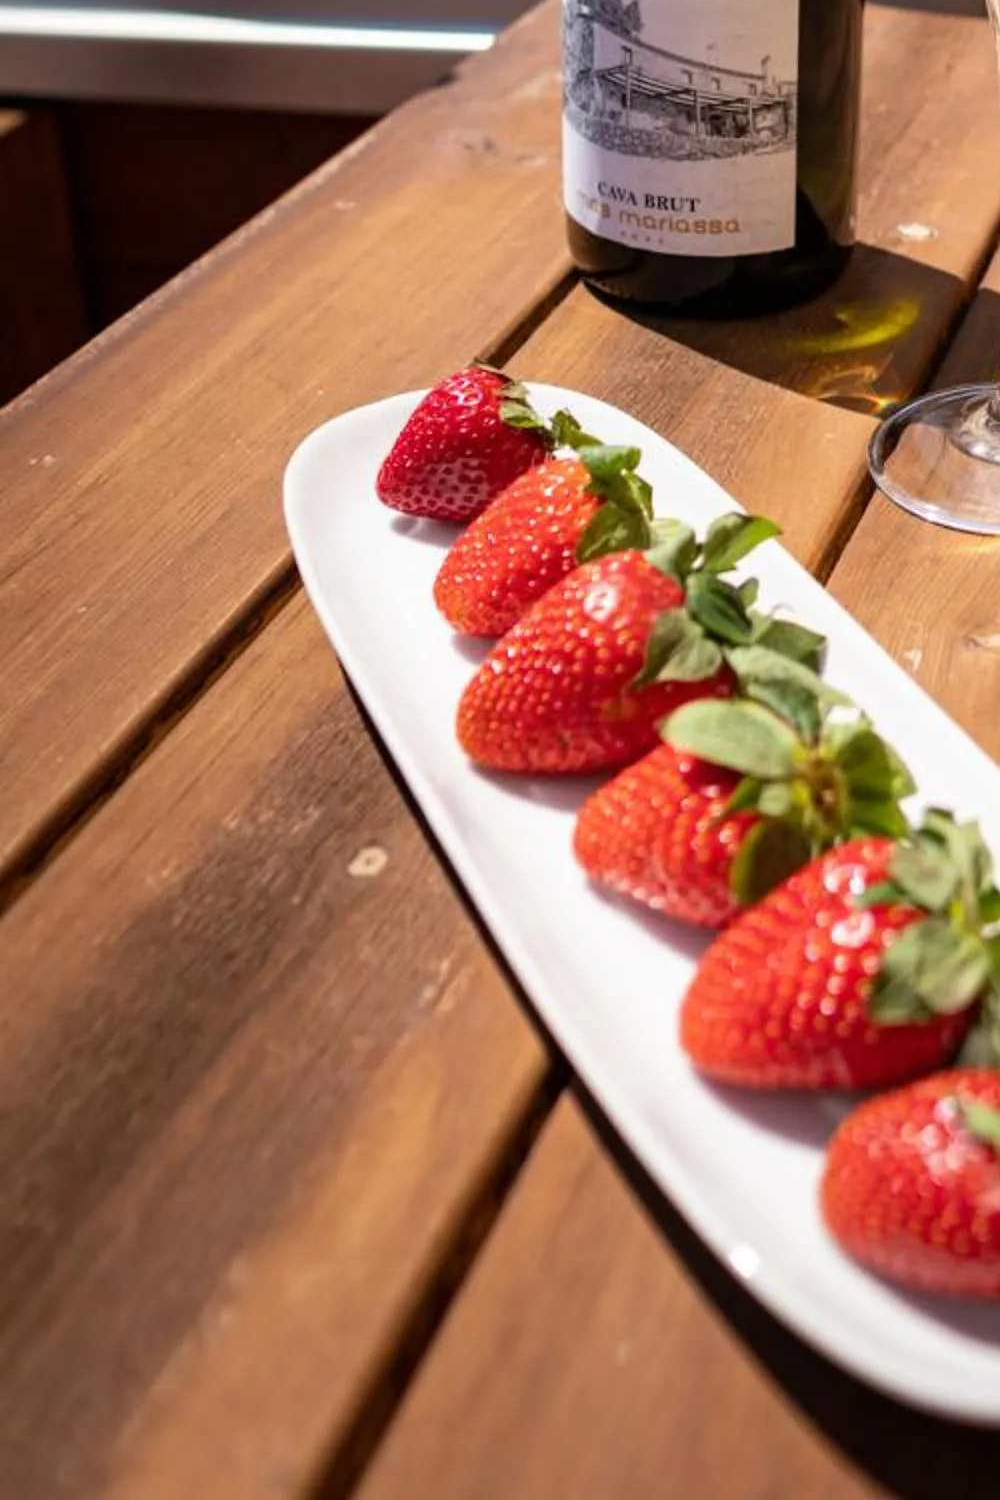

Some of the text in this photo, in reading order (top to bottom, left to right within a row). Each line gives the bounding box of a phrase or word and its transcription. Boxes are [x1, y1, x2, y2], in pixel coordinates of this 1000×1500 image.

[597, 181, 637, 206] CAVA
[643, 193, 700, 213] BRUT
[619, 209, 741, 234] mariassa
